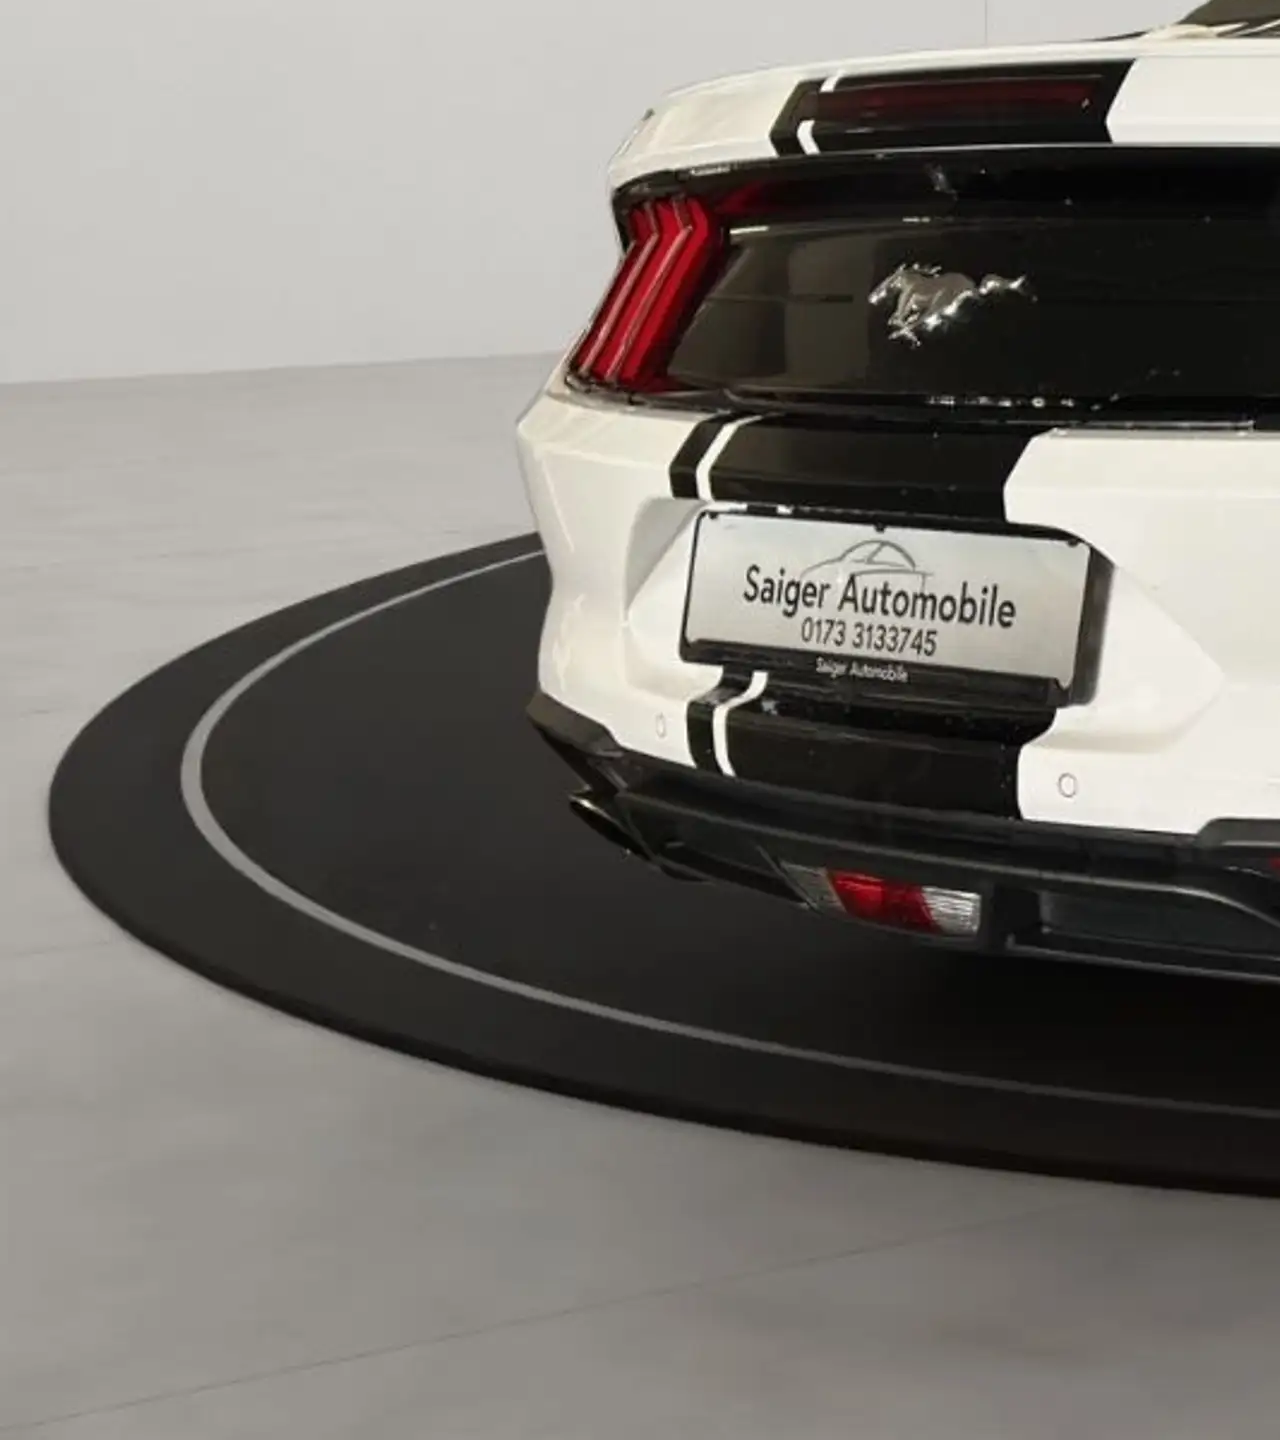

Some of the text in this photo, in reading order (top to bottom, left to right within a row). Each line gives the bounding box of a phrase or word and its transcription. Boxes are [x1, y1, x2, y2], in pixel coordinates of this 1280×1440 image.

[743, 565, 1017, 629] Saiger Automobile
[801, 617, 938, 657] 0173 3133745
[816, 656, 910, 684] Saiger Automobile
